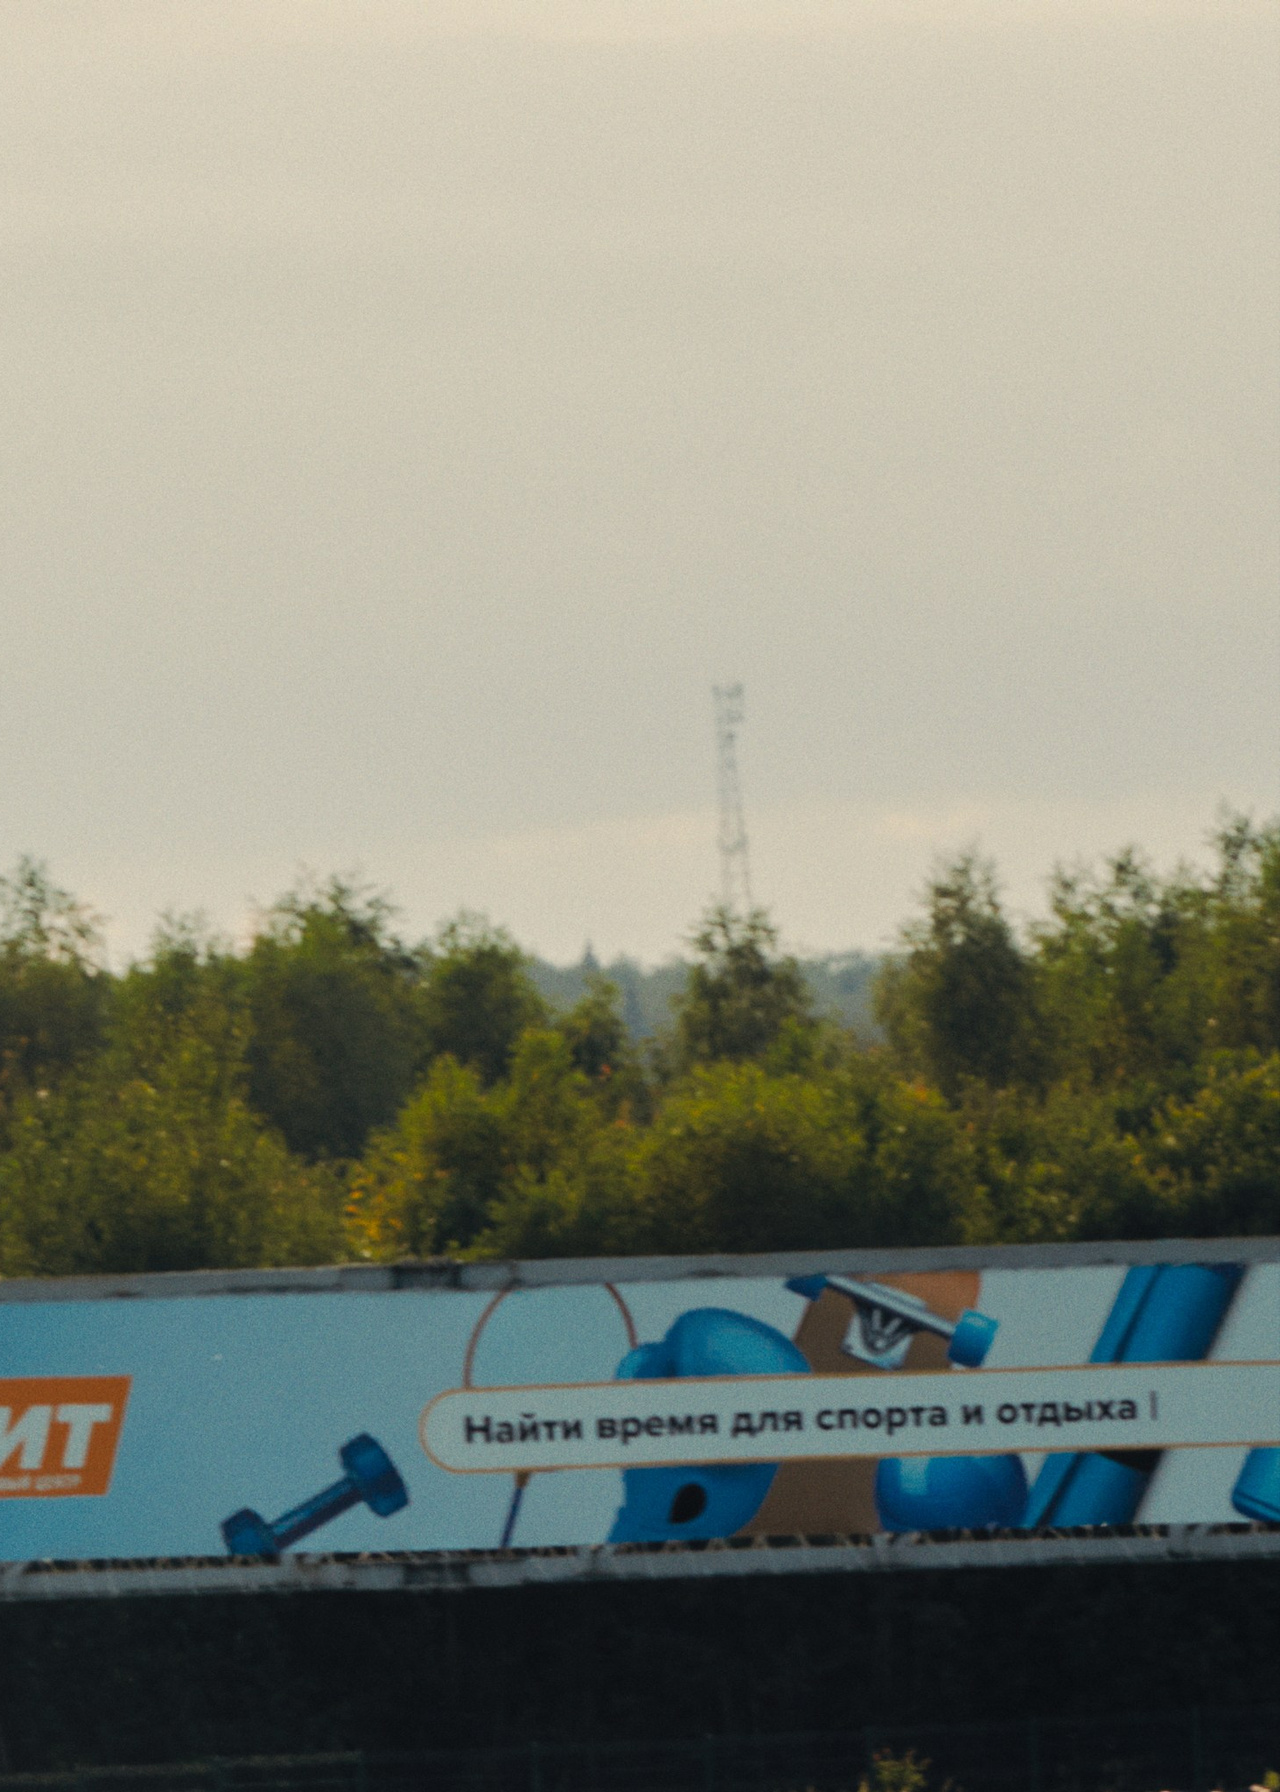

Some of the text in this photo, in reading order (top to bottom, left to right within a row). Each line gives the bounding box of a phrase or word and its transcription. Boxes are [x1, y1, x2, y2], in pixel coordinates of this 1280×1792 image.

[464, 1397, 1139, 1446] Найти время для спорта и отдыха
